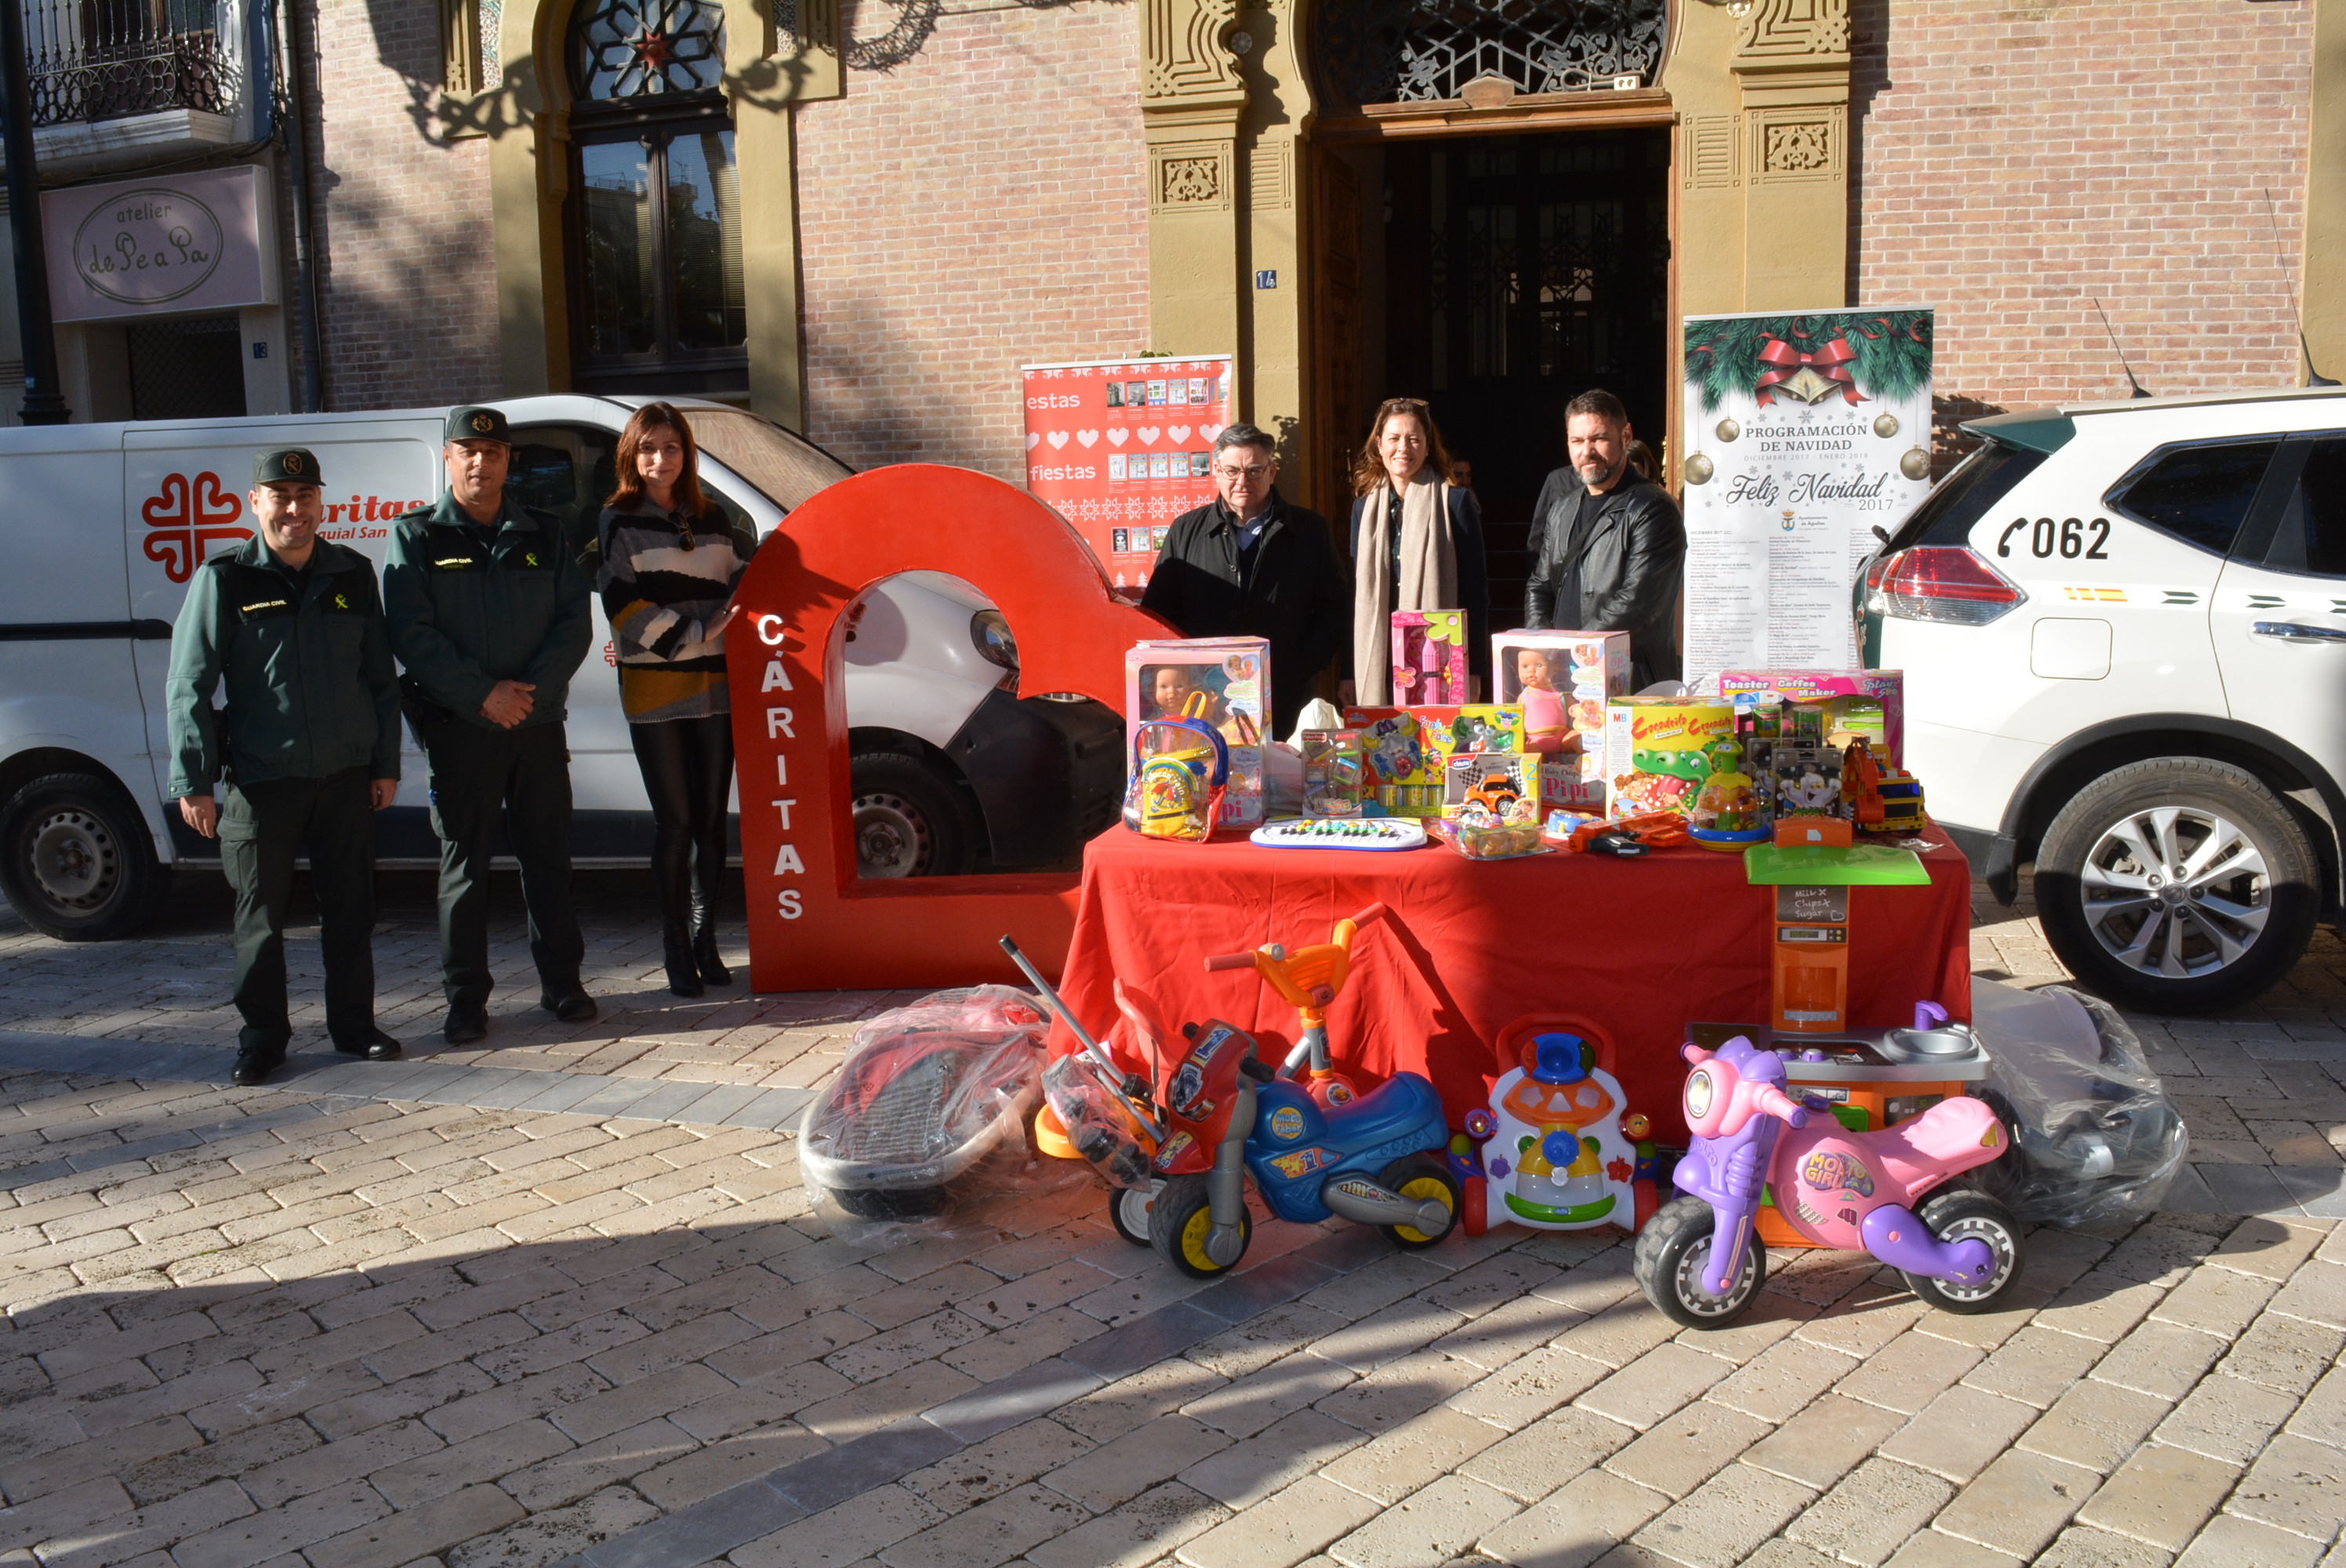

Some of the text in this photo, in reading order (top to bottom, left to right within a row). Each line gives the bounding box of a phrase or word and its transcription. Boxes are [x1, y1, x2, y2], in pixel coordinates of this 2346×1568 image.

[118, 202, 172, 223] atelier
[89, 226, 209, 274] de Pe a Pa
[1258, 270, 1276, 288] 14
[1026, 393, 1080, 409] estas
[1745, 423, 1868, 438] PROGRAMACIÓN
[1760, 439, 1852, 452] DE NAVIDAD
[1030, 464, 1096, 481] fiestas
[1726, 471, 1889, 507] Feliz Navidad
[1858, 499, 1894, 510] 2017
[358, 526, 388, 539] San
[2032, 517, 2112, 561] 062
[242, 601, 271, 612] GUARDIA
[1722, 678, 1770, 690] Toaster
[1776, 678, 1817, 688] Coffee
[1797, 688, 1838, 698] Maker
[1419, 715, 1446, 735] Funky
[1613, 713, 1627, 722] MB
[1631, 713, 1687, 740] Cocodrilo
[1430, 729, 1452, 744] Face
[1526, 764, 1537, 780] 2
[1794, 899, 1821, 910] Chips
[1195, 1028, 1234, 1059] 1
[1276, 1112, 1302, 1123] Moto
[1298, 1148, 1320, 1173] 1
[1805, 1167, 1841, 1188] GIRL
